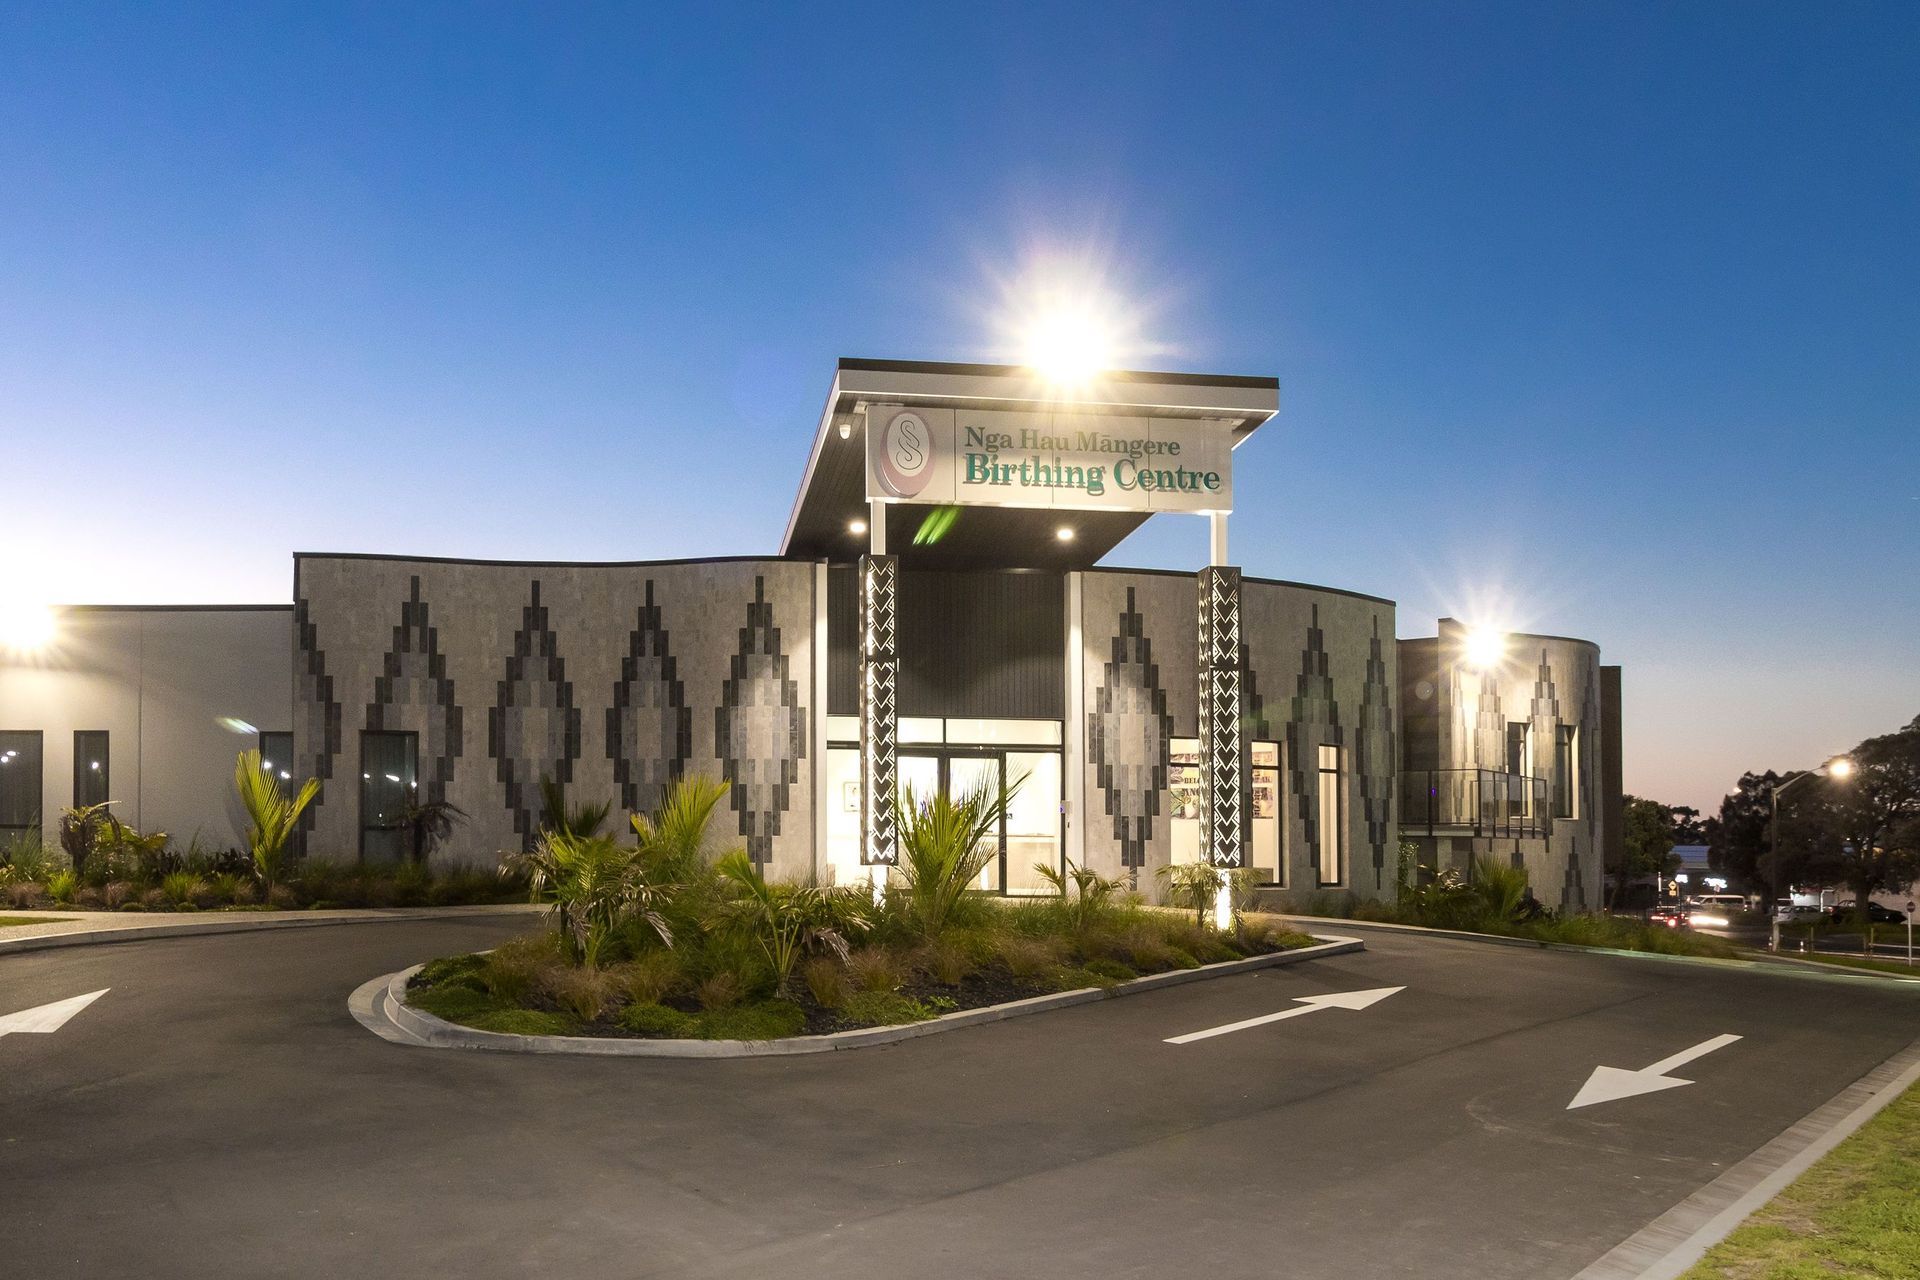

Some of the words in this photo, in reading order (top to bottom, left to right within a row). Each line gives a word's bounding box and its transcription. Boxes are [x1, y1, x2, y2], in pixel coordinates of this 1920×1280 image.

[964, 425, 1014, 453] Nga
[1019, 428, 1070, 451] Hau
[1075, 431, 1181, 459] Māngere
[963, 452, 1104, 496] Birthing
[1113, 458, 1222, 493] Centre
